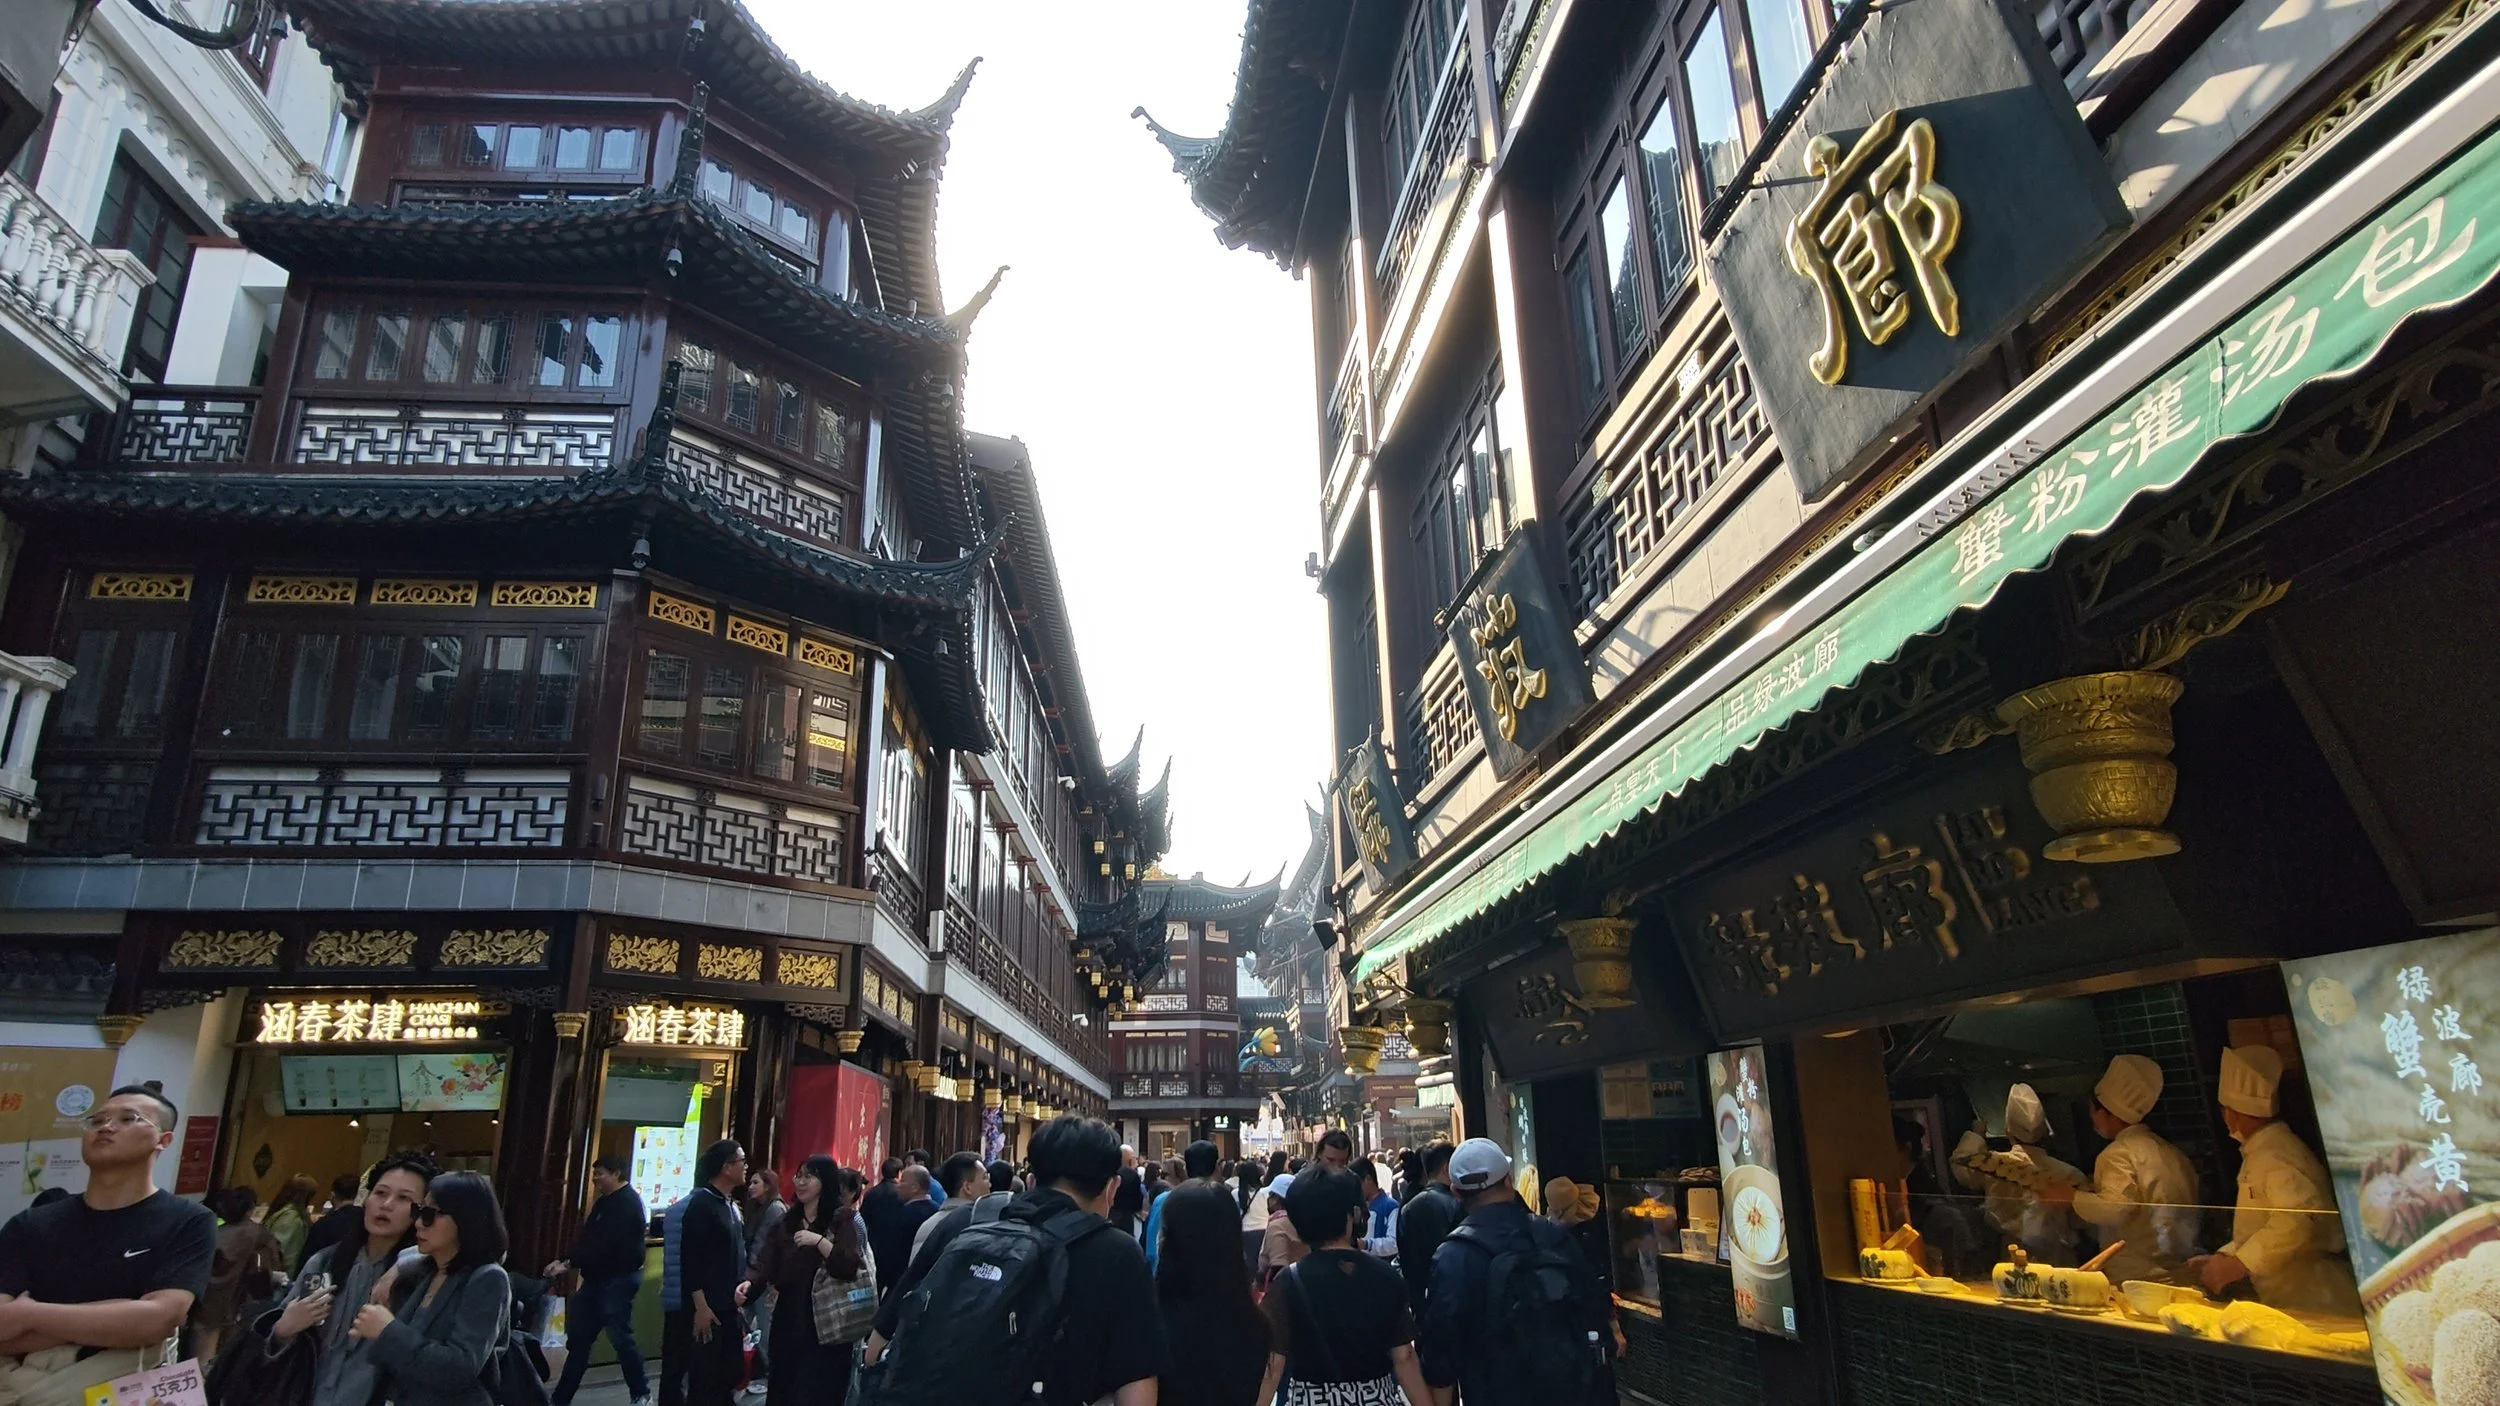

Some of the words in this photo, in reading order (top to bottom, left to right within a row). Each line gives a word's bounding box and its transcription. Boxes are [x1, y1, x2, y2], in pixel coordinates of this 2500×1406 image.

[1785, 109, 1960, 386] 廊
[1950, 197, 2477, 588] 蟹粉灌汤包
[256, 999, 405, 1043] 涵春茶肆
[409, 1002, 480, 1015] HANCHUN
[623, 1005, 745, 1047] 涵春茶肆
[2396, 965, 2483, 1097] 绿波廊
[2380, 1010, 2469, 1193] 蟹壳黄
[152, 1376, 198, 1398] 巧克力
